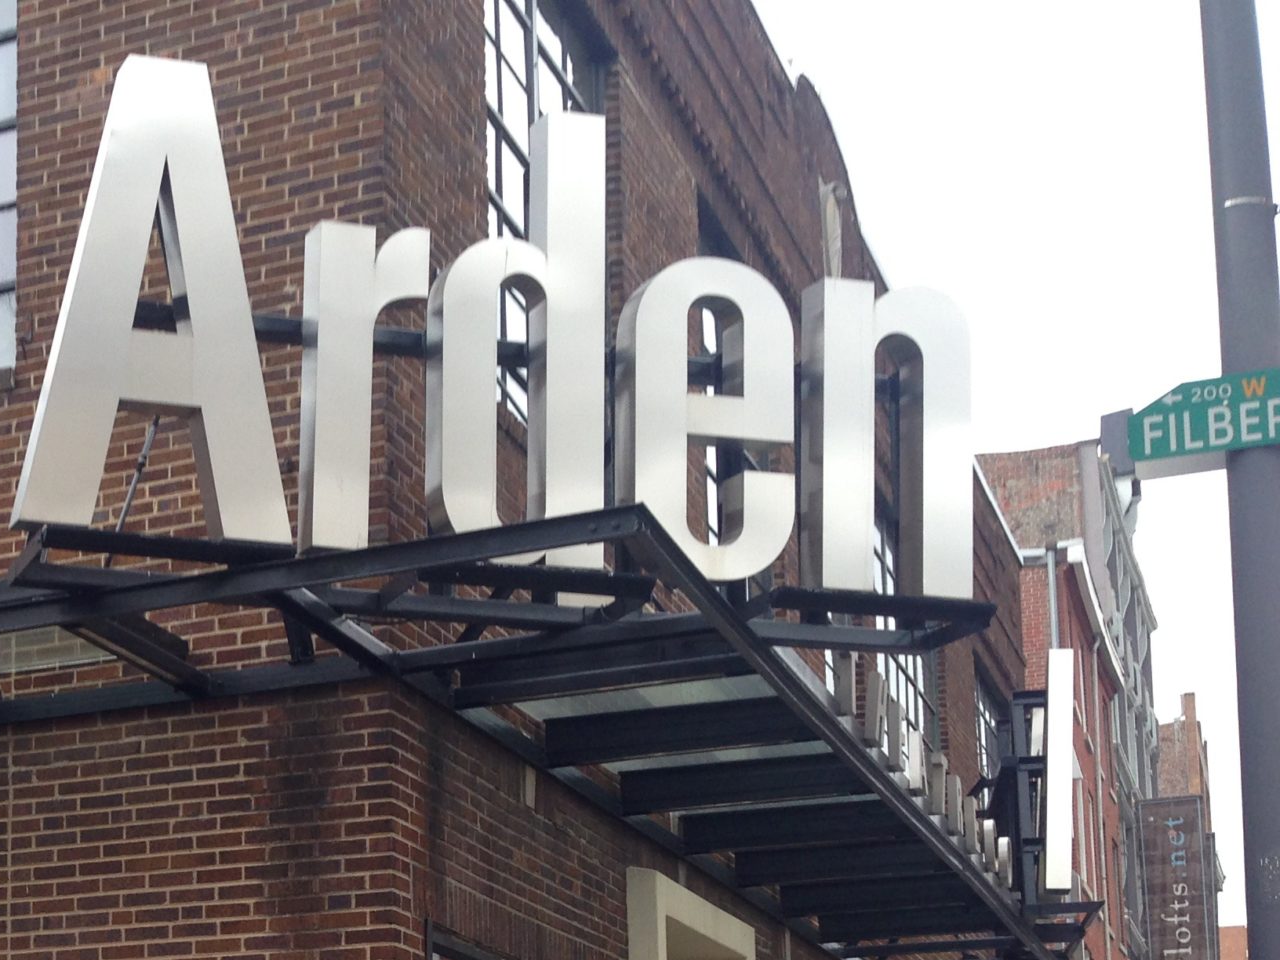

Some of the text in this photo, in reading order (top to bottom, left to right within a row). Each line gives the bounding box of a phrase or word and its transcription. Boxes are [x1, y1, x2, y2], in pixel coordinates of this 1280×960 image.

[10, 54, 973, 602] Arden
[1191, 376, 1267, 403] 200 W
